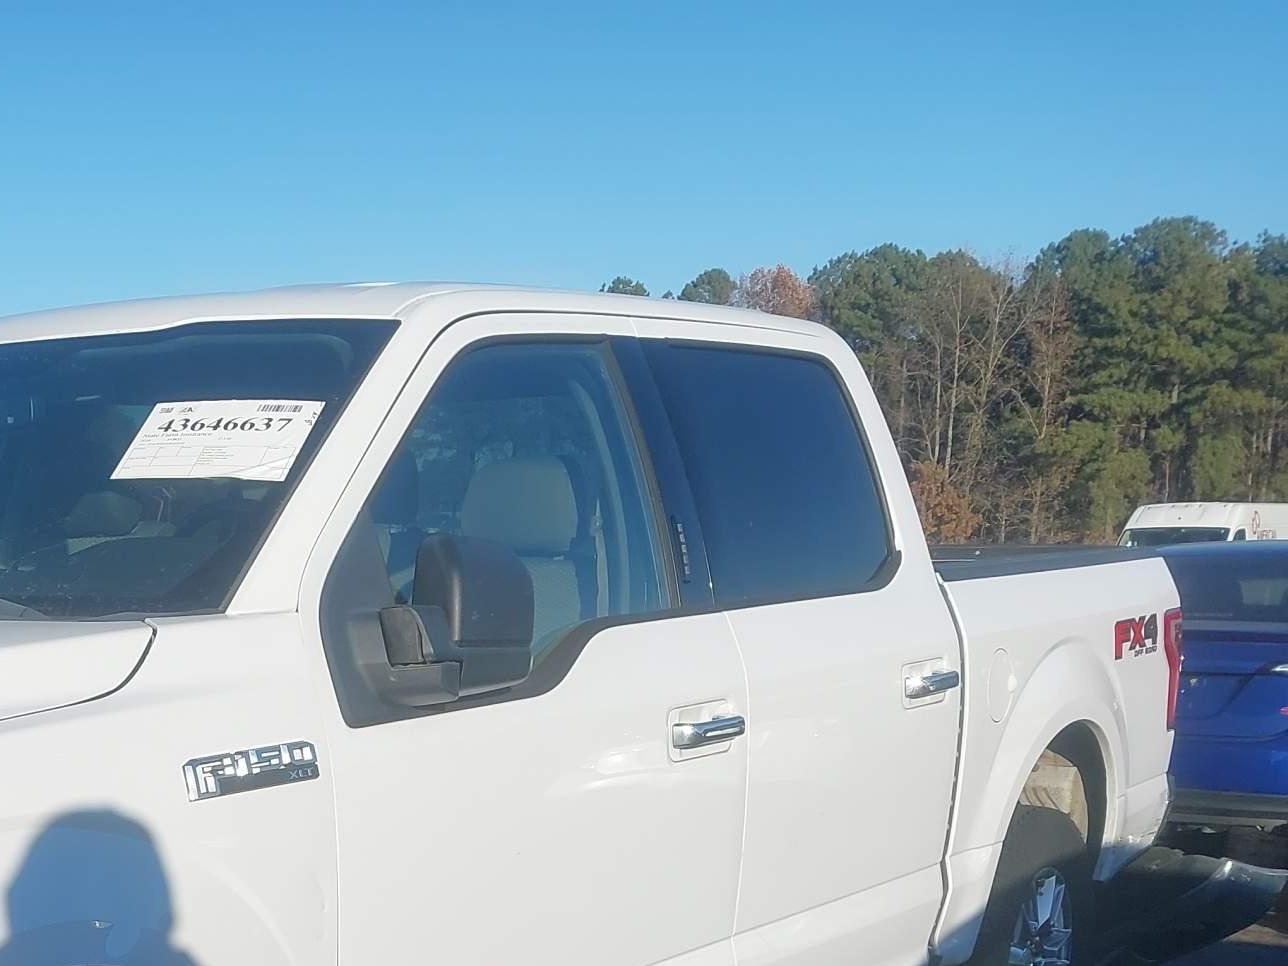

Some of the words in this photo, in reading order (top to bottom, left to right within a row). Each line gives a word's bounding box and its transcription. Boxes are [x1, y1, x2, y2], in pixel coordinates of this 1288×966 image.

[158, 417, 293, 432] 43646637
[1114, 613, 1158, 660] FX4
[289, 766, 314, 780] XLT
